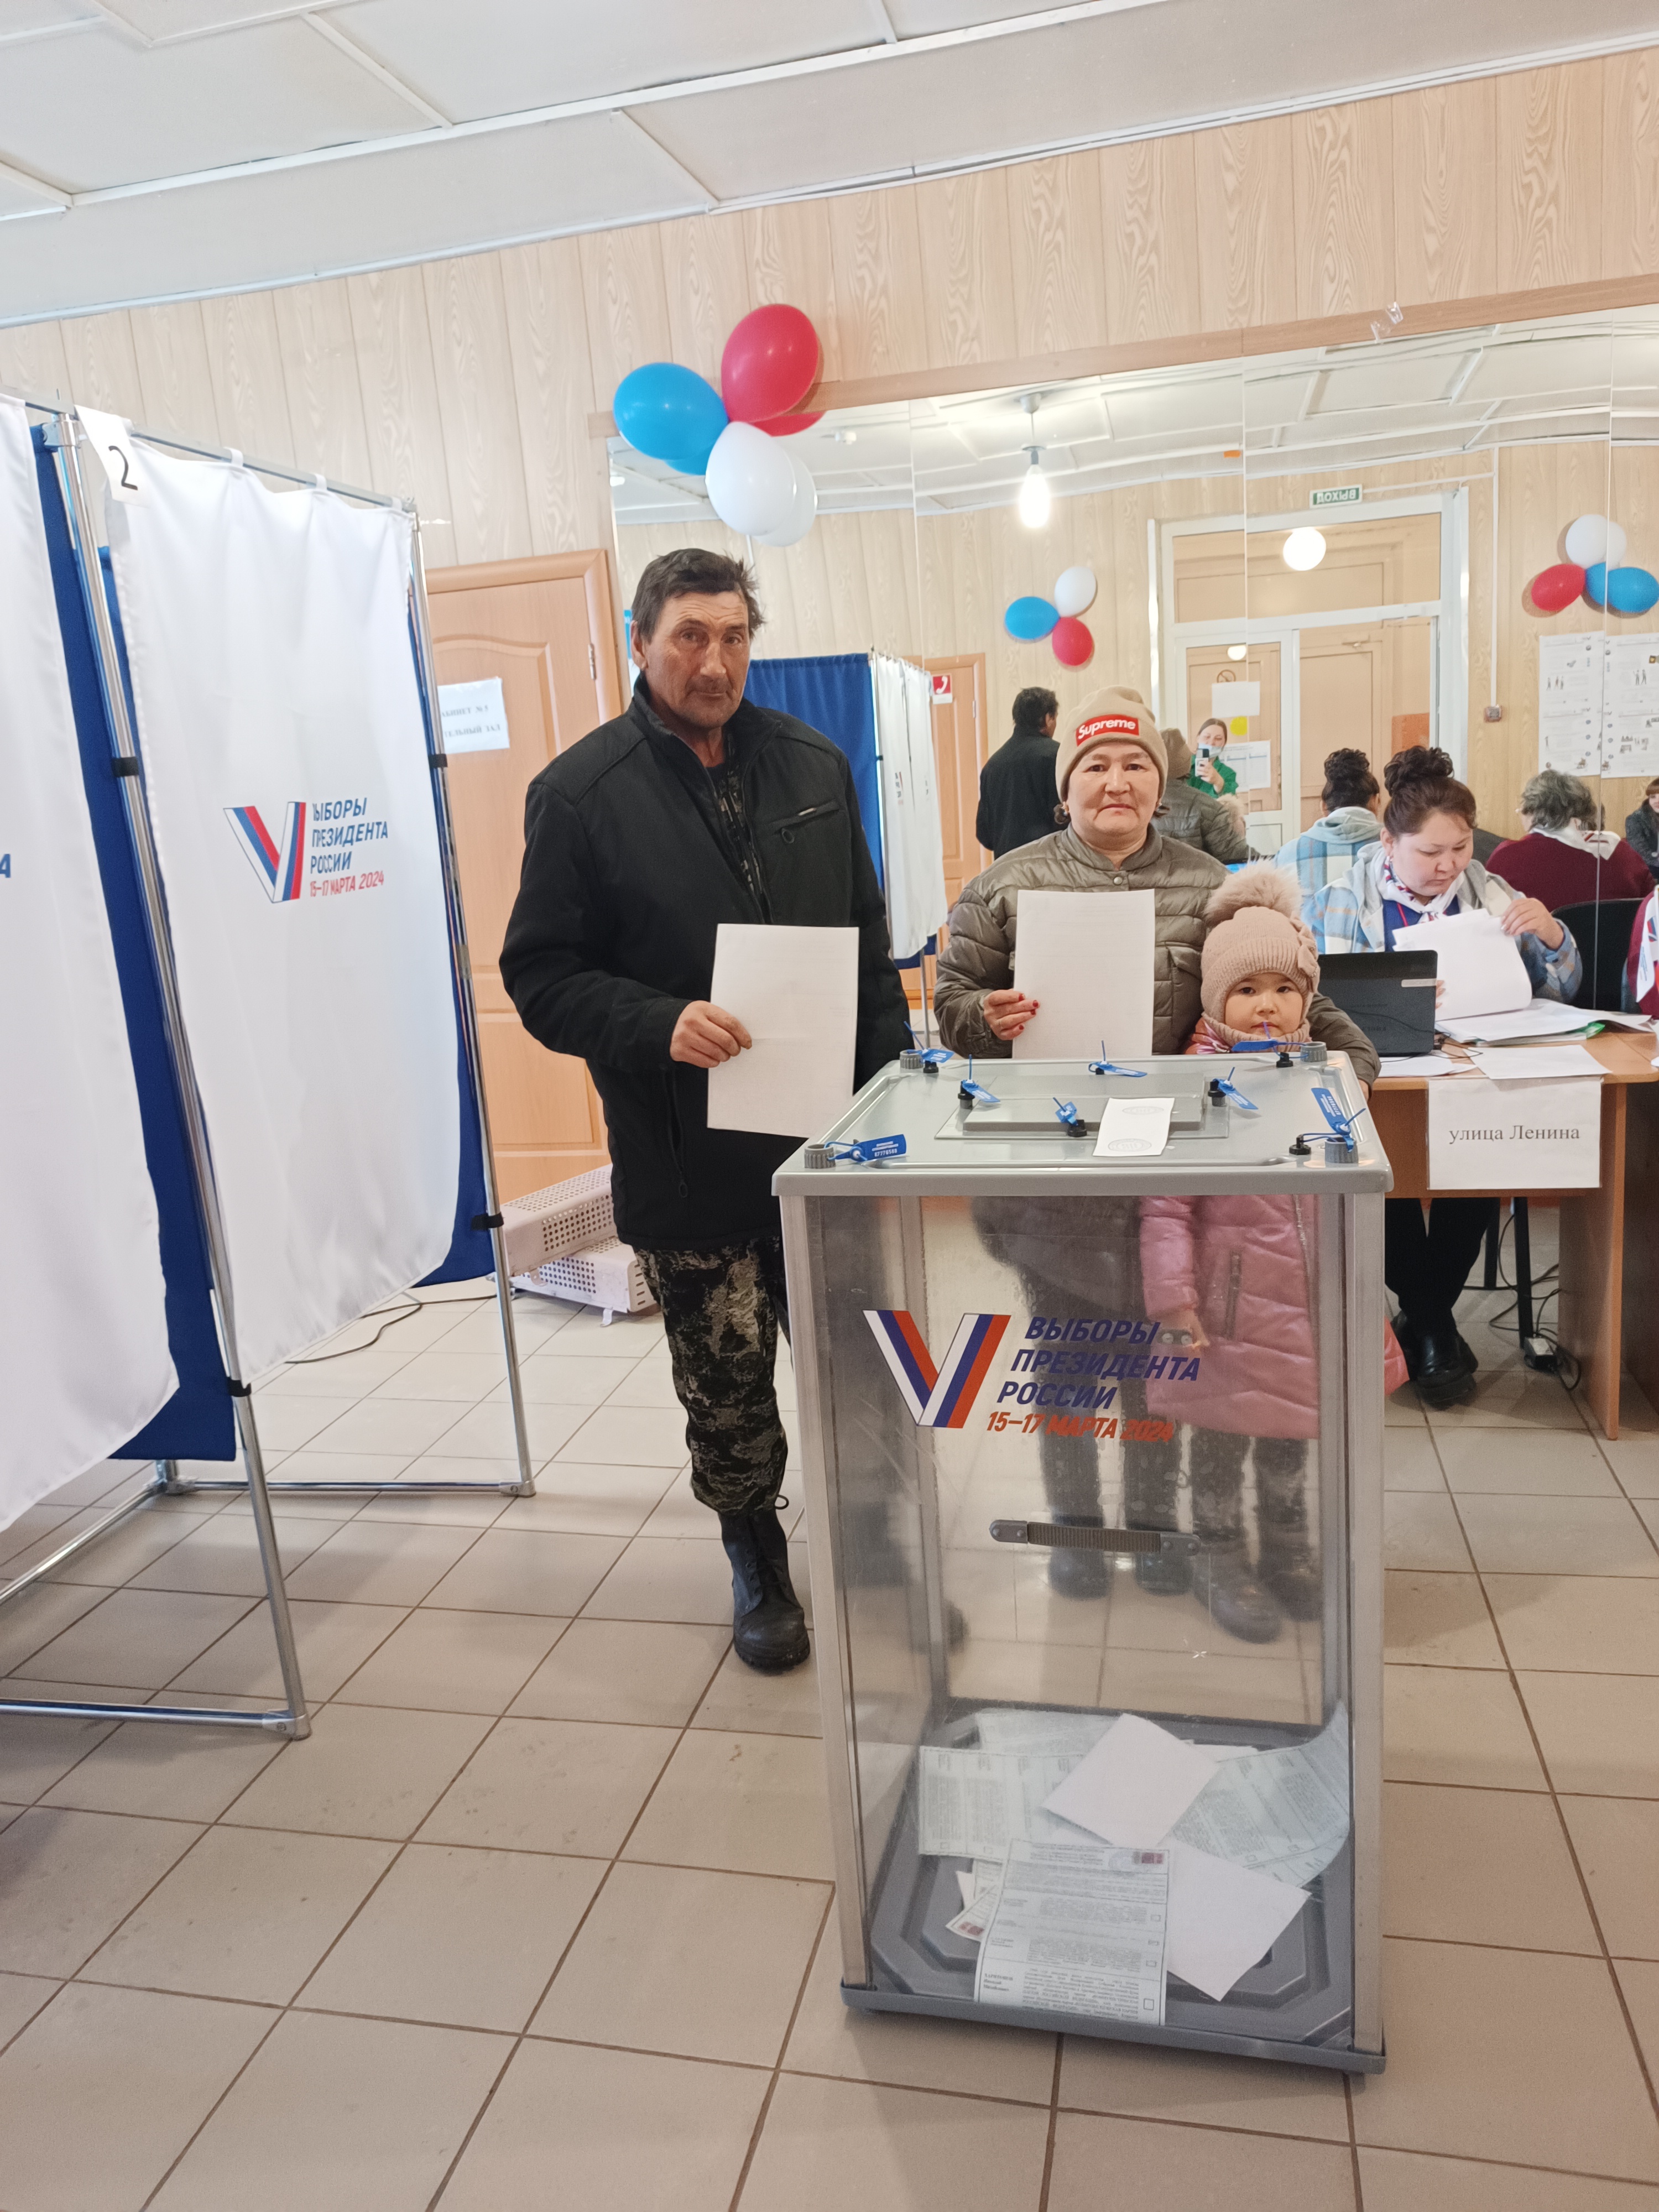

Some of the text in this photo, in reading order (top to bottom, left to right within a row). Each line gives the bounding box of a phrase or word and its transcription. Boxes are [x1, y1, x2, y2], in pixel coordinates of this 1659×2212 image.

[108, 445, 138, 491] 2
[1078, 719, 1136, 739] Supreme
[312, 797, 367, 822] ЫБОРЫ
[310, 851, 352, 874] РОССИИ
[358, 870, 384, 890] 2024
[1449, 1125, 1580, 1145] улица Ленина
[1025, 1317, 1161, 1344] ВЫБОРЫ
[1010, 1349, 1201, 1381] ПРЕЗИДЕНТА
[997, 1381, 1118, 1409] РОССИИ
[1045, 1415, 1118, 1438] МАРТА
[1119, 1420, 1173, 1442] 2024
